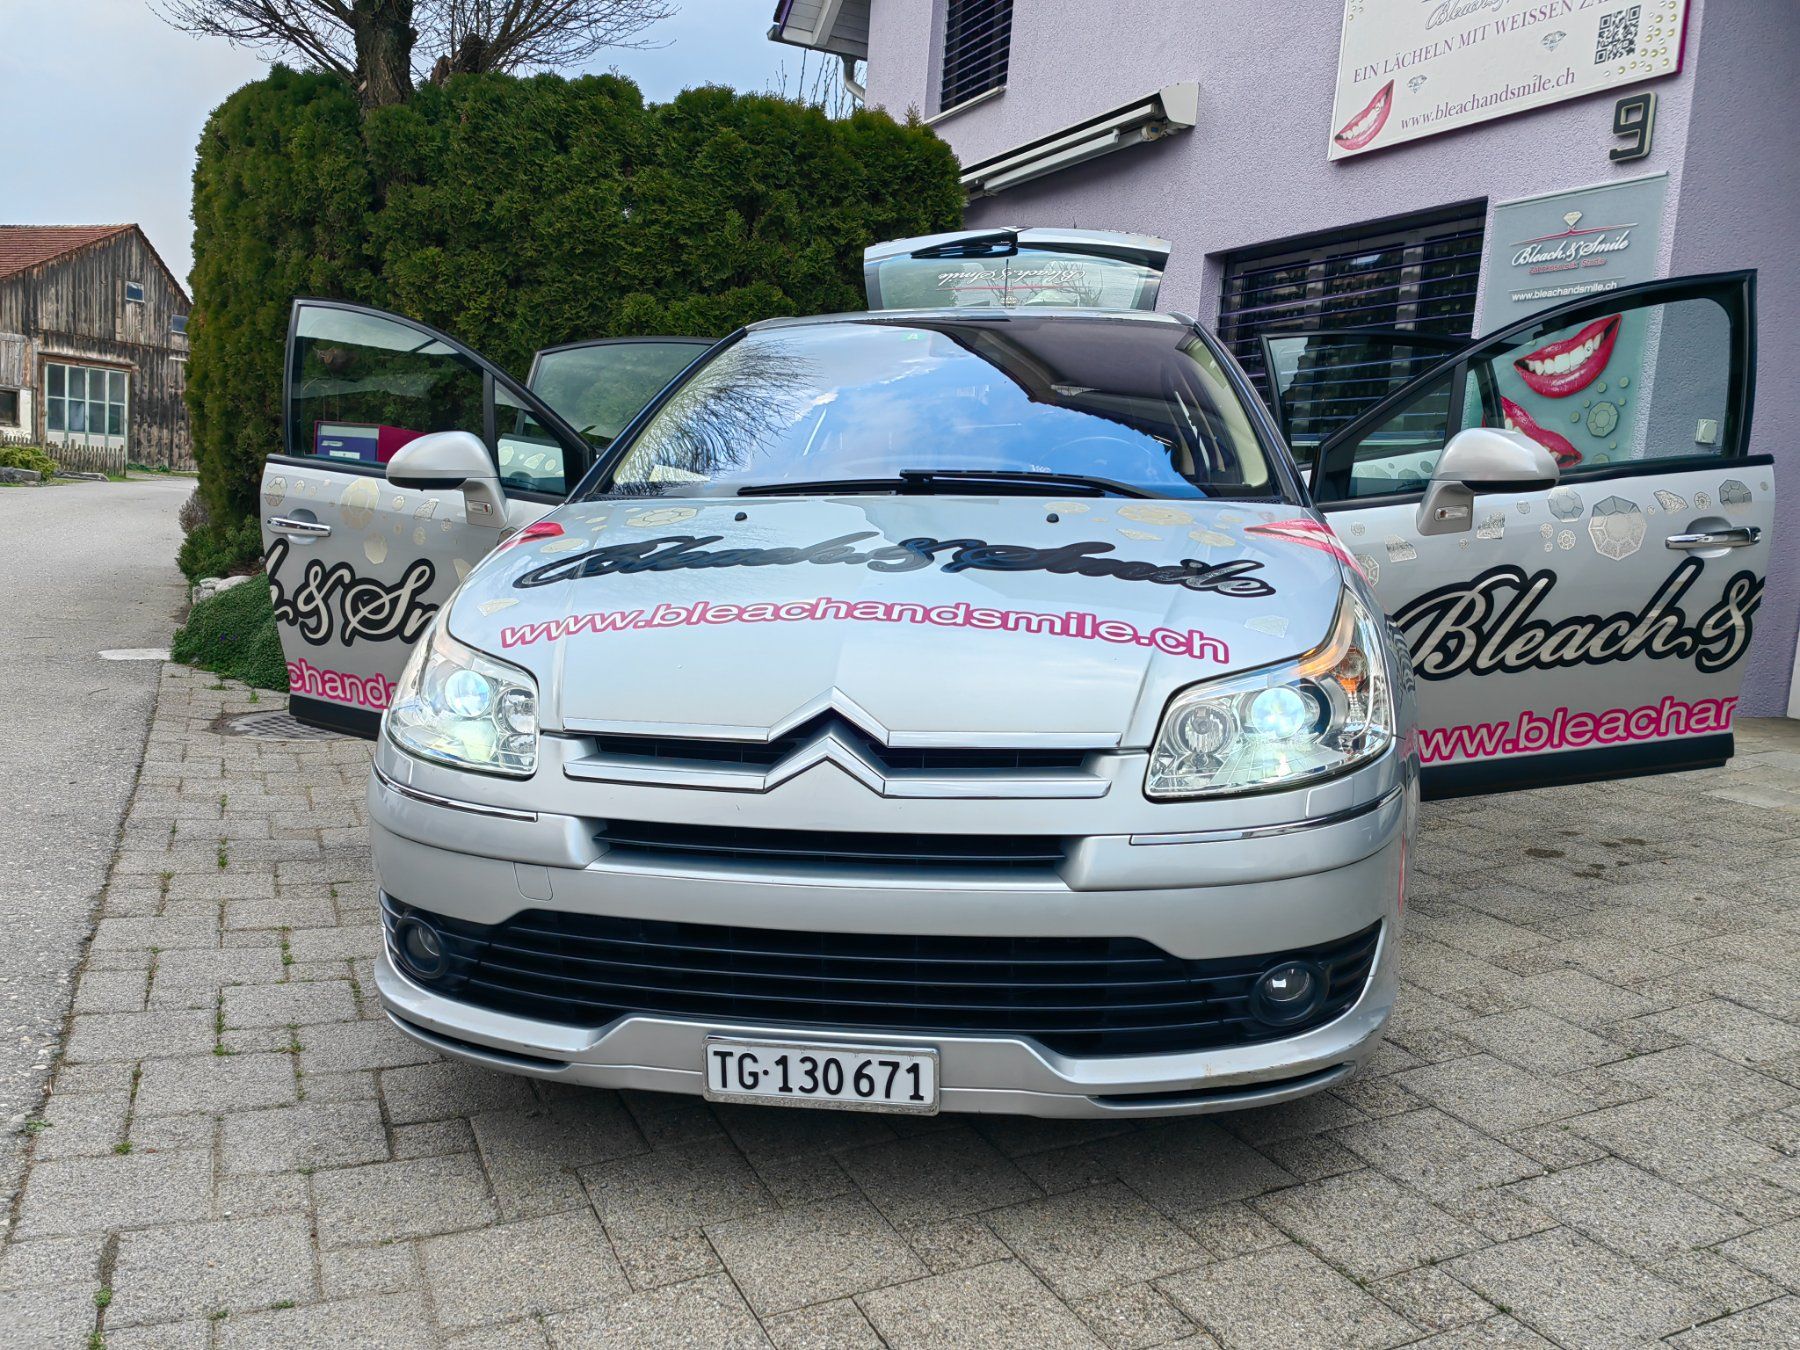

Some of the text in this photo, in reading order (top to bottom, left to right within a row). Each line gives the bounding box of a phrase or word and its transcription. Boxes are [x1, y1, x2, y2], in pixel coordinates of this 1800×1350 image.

[1353, 0, 1573, 83] EIN LÄCHELN MIT WEISSEN
[1400, 67, 1575, 130] www.bleachandsmile.ch
[1609, 92, 1658, 162] 9
[1578, 230, 1631, 259] Smile
[1511, 280, 1618, 301] www.bleachandsmile.ch
[500, 597, 1230, 664] www.bleachandsmile.ch
